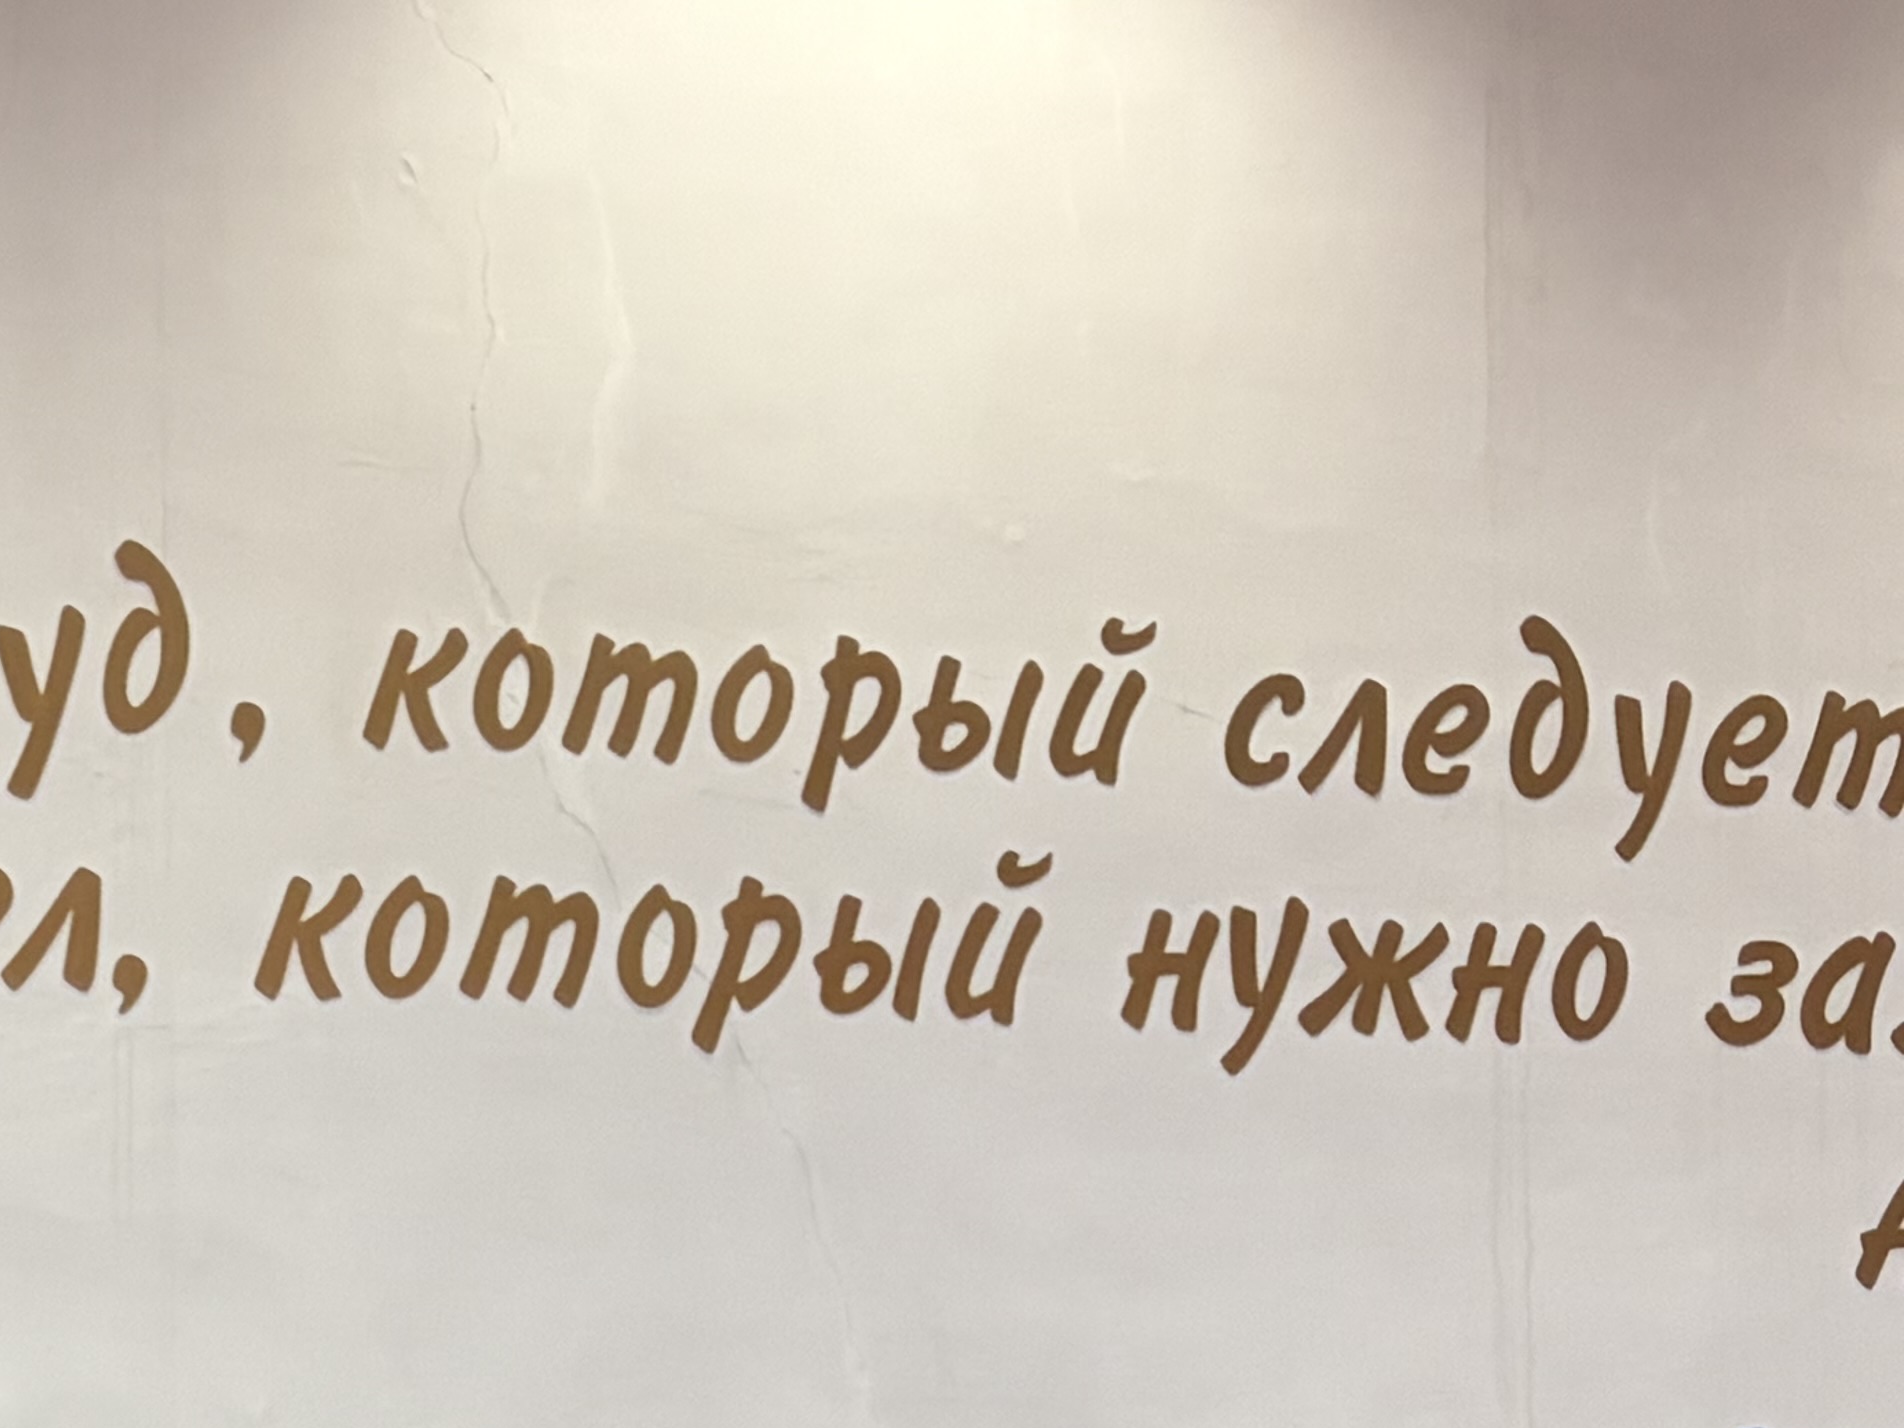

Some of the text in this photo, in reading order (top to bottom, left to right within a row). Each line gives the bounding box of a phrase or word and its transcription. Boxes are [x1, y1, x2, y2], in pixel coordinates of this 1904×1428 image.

[365, 619, 1154, 809] который
[1226, 617, 1904, 860] следует
[257, 853, 1050, 1051] который
[1124, 899, 1627, 1073] нужно
[1707, 934, 1904, 1053] за
